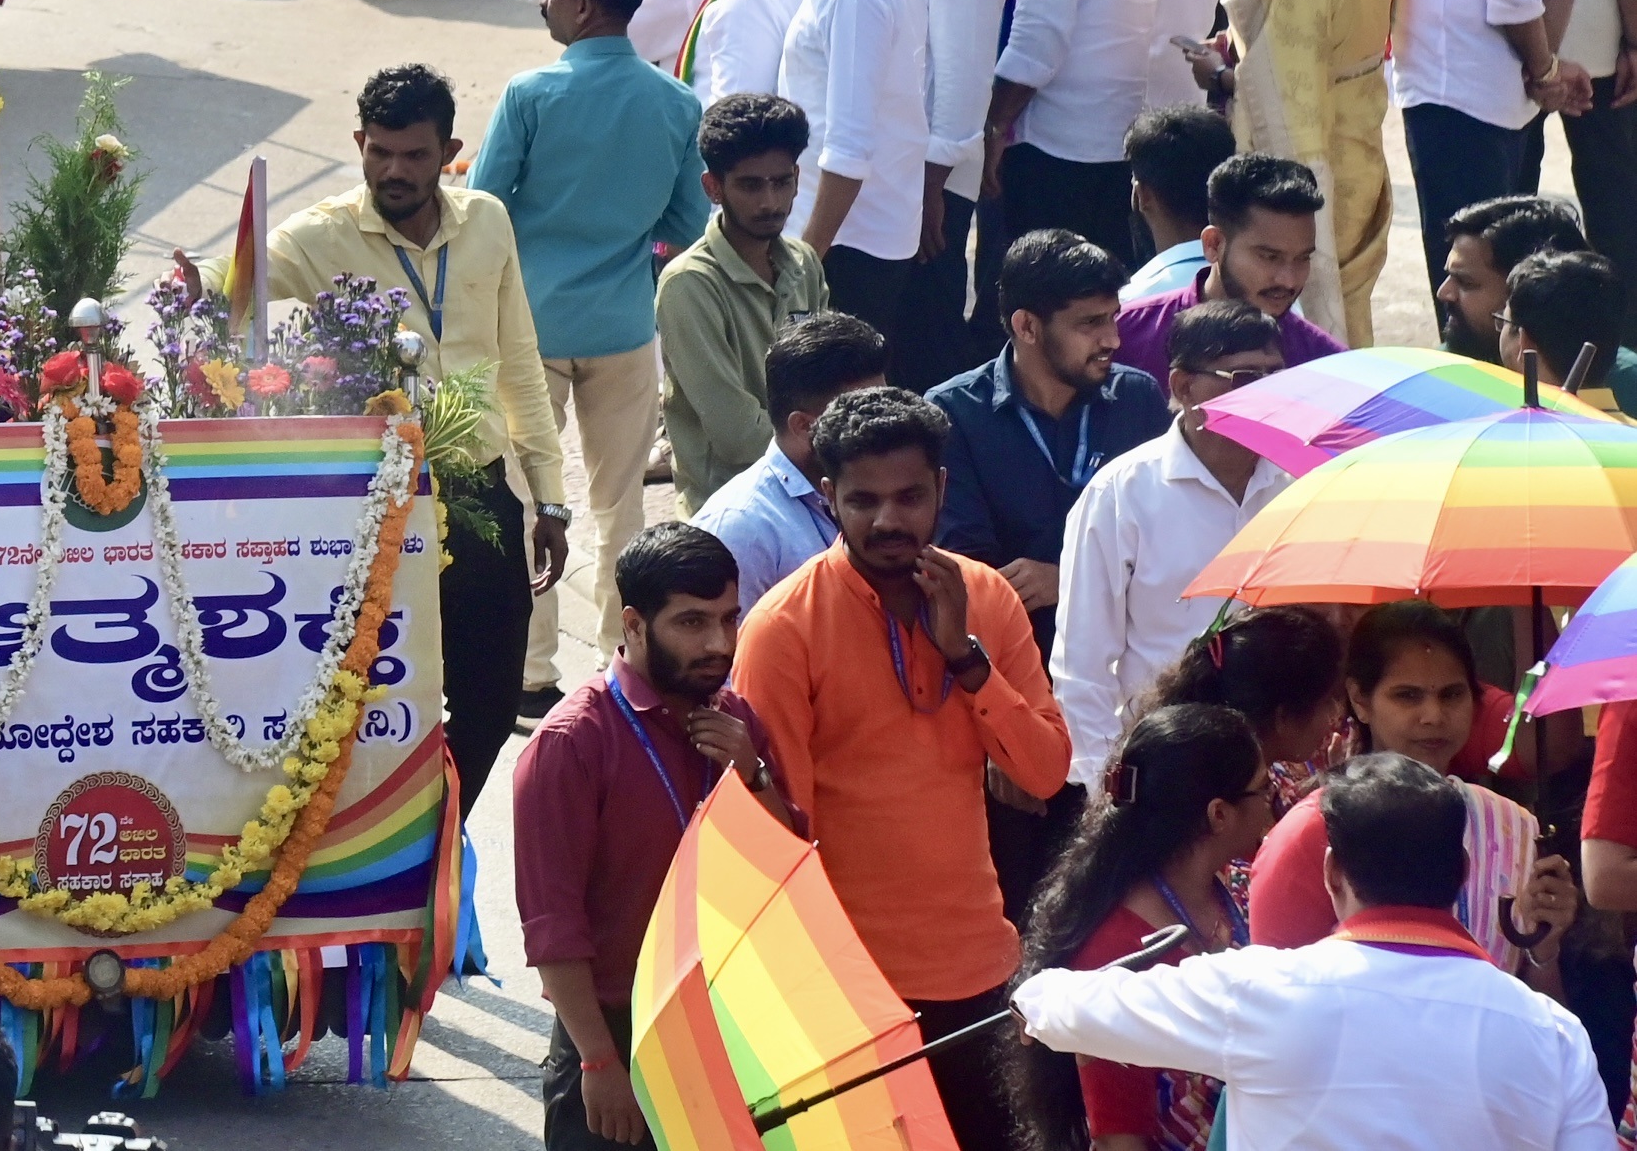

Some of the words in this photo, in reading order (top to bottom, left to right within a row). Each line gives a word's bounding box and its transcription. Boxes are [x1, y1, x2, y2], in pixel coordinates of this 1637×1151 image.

[56, 544, 95, 565] ಖಿಲ
[103, 541, 154, 564] ಭಾರತ
[236, 536, 301, 564] ಸಪ್ತಾಹದ
[60, 812, 118, 866] 72
[119, 828, 158, 842] ಅಖಿಲ
[119, 845, 166, 863] ಭಾರತ
[57, 871, 112, 890] ಸಹಕಾರ
